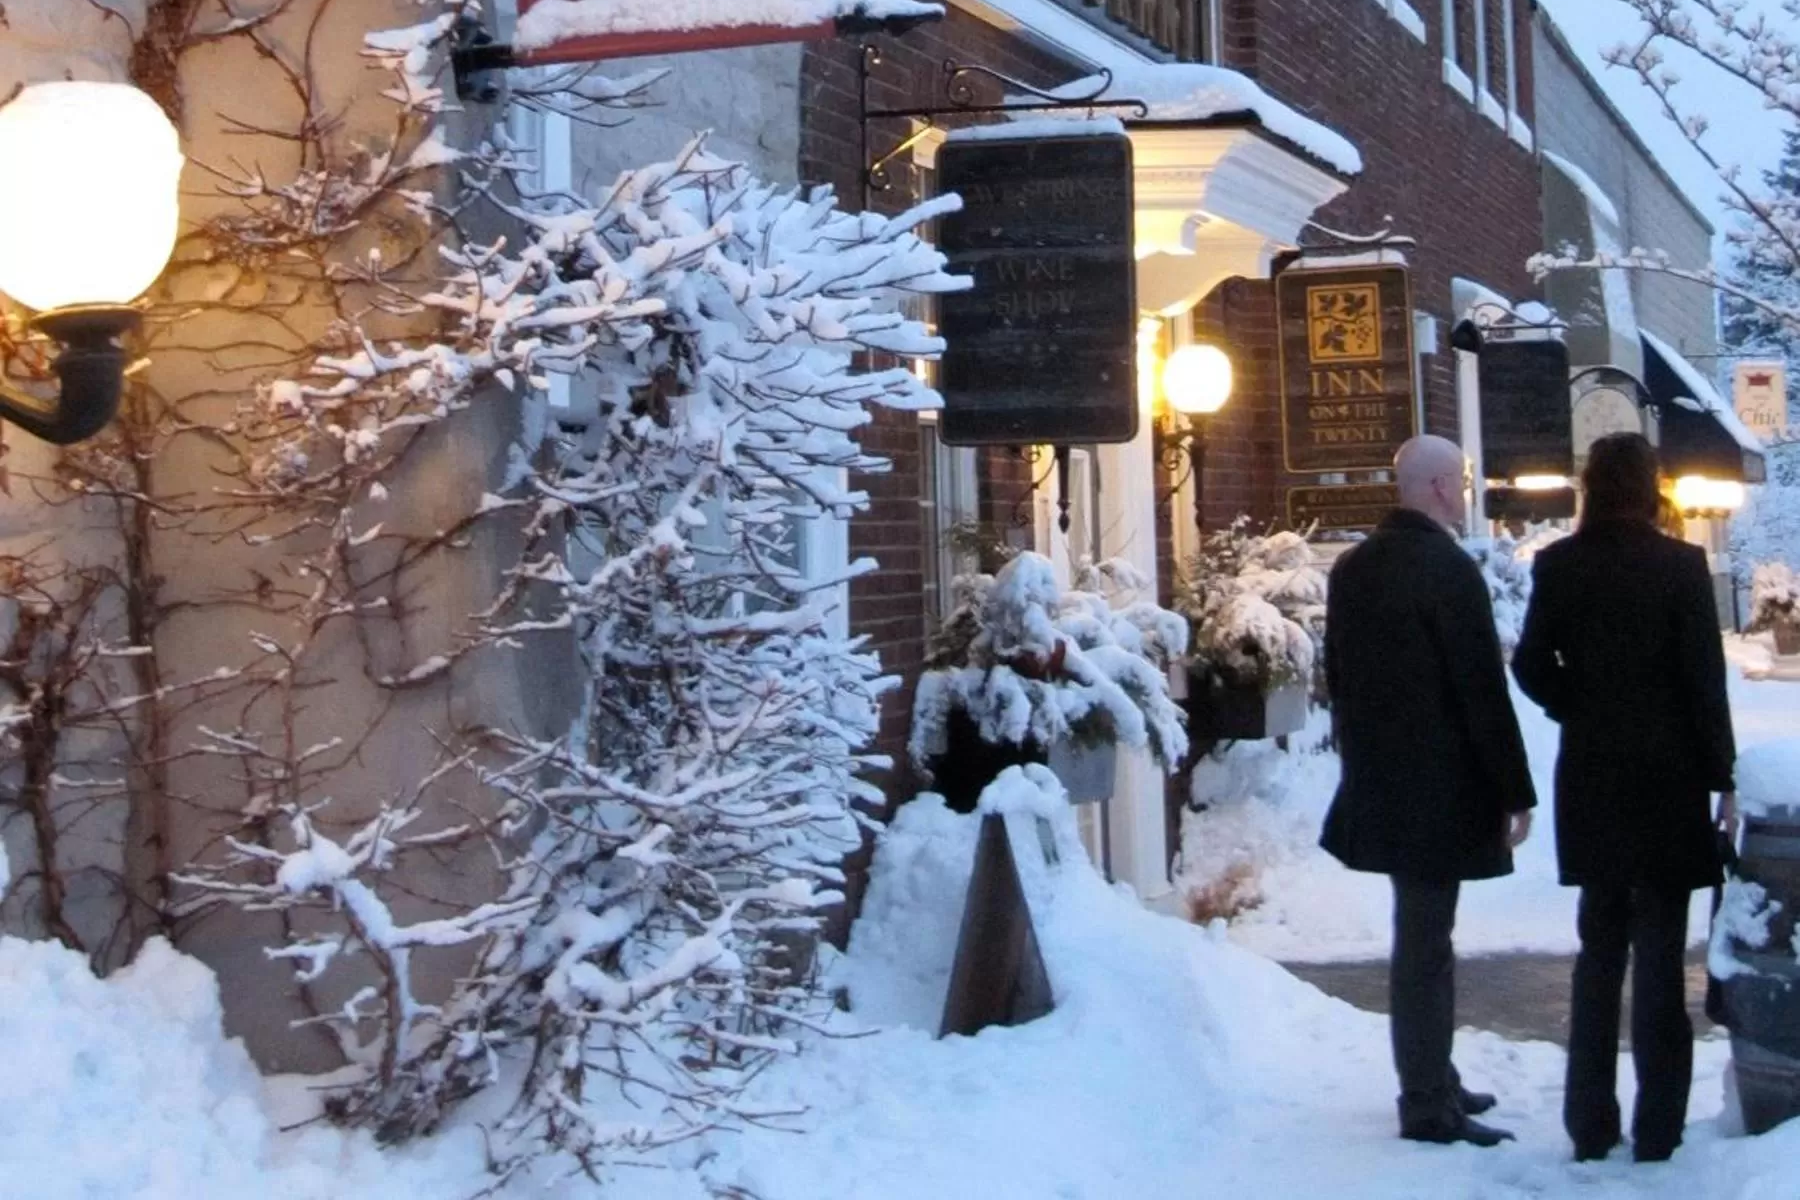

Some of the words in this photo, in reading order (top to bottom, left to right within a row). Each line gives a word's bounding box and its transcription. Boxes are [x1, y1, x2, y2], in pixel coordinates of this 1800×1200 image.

[996, 257, 1075, 281] WINE
[1311, 368, 1385, 398] INN
[1308, 404, 1336, 420] ON
[1350, 402, 1388, 418] THE
[1309, 426, 1390, 444] TWENTY
